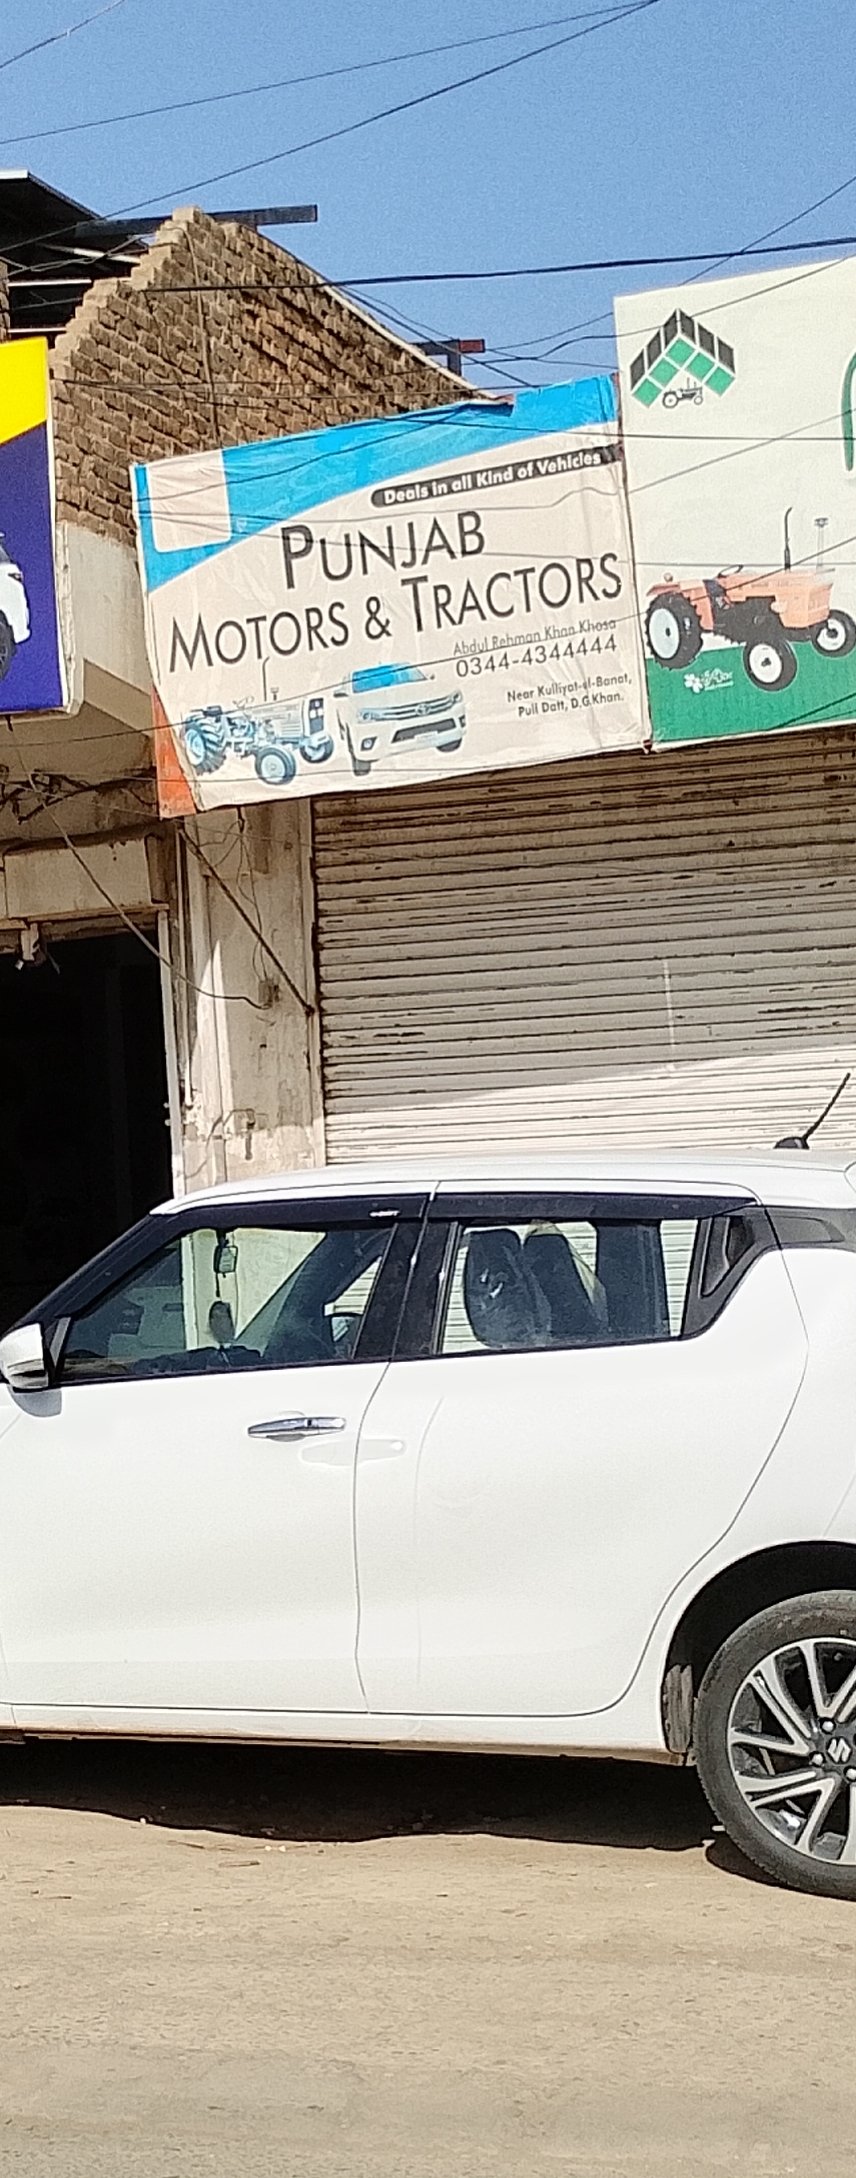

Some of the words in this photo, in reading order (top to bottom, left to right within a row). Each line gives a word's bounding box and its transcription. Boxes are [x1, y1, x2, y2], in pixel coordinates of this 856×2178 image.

[384, 485, 428, 504] Deals
[432, 480, 448, 496] in
[452, 475, 472, 492] all
[477, 467, 514, 488] Kind
[517, 463, 534, 479] of
[537, 451, 602, 475] Vehicles
[281, 511, 485, 589] PUNJAB
[168, 602, 349, 673] MOTORS
[364, 596, 392, 639] &
[400, 553, 622, 632] TRACTORS
[453, 638, 488, 656] Abdul
[492, 630, 541, 648] Rehman
[544, 626, 575, 641] Khan
[579, 619, 617, 634] Khosa
[455, 633, 618, 677] 0344-4344444
[507, 690, 535, 703] Near
[518, 706, 539, 717] Pull
[542, 700, 568, 713] Datt,
